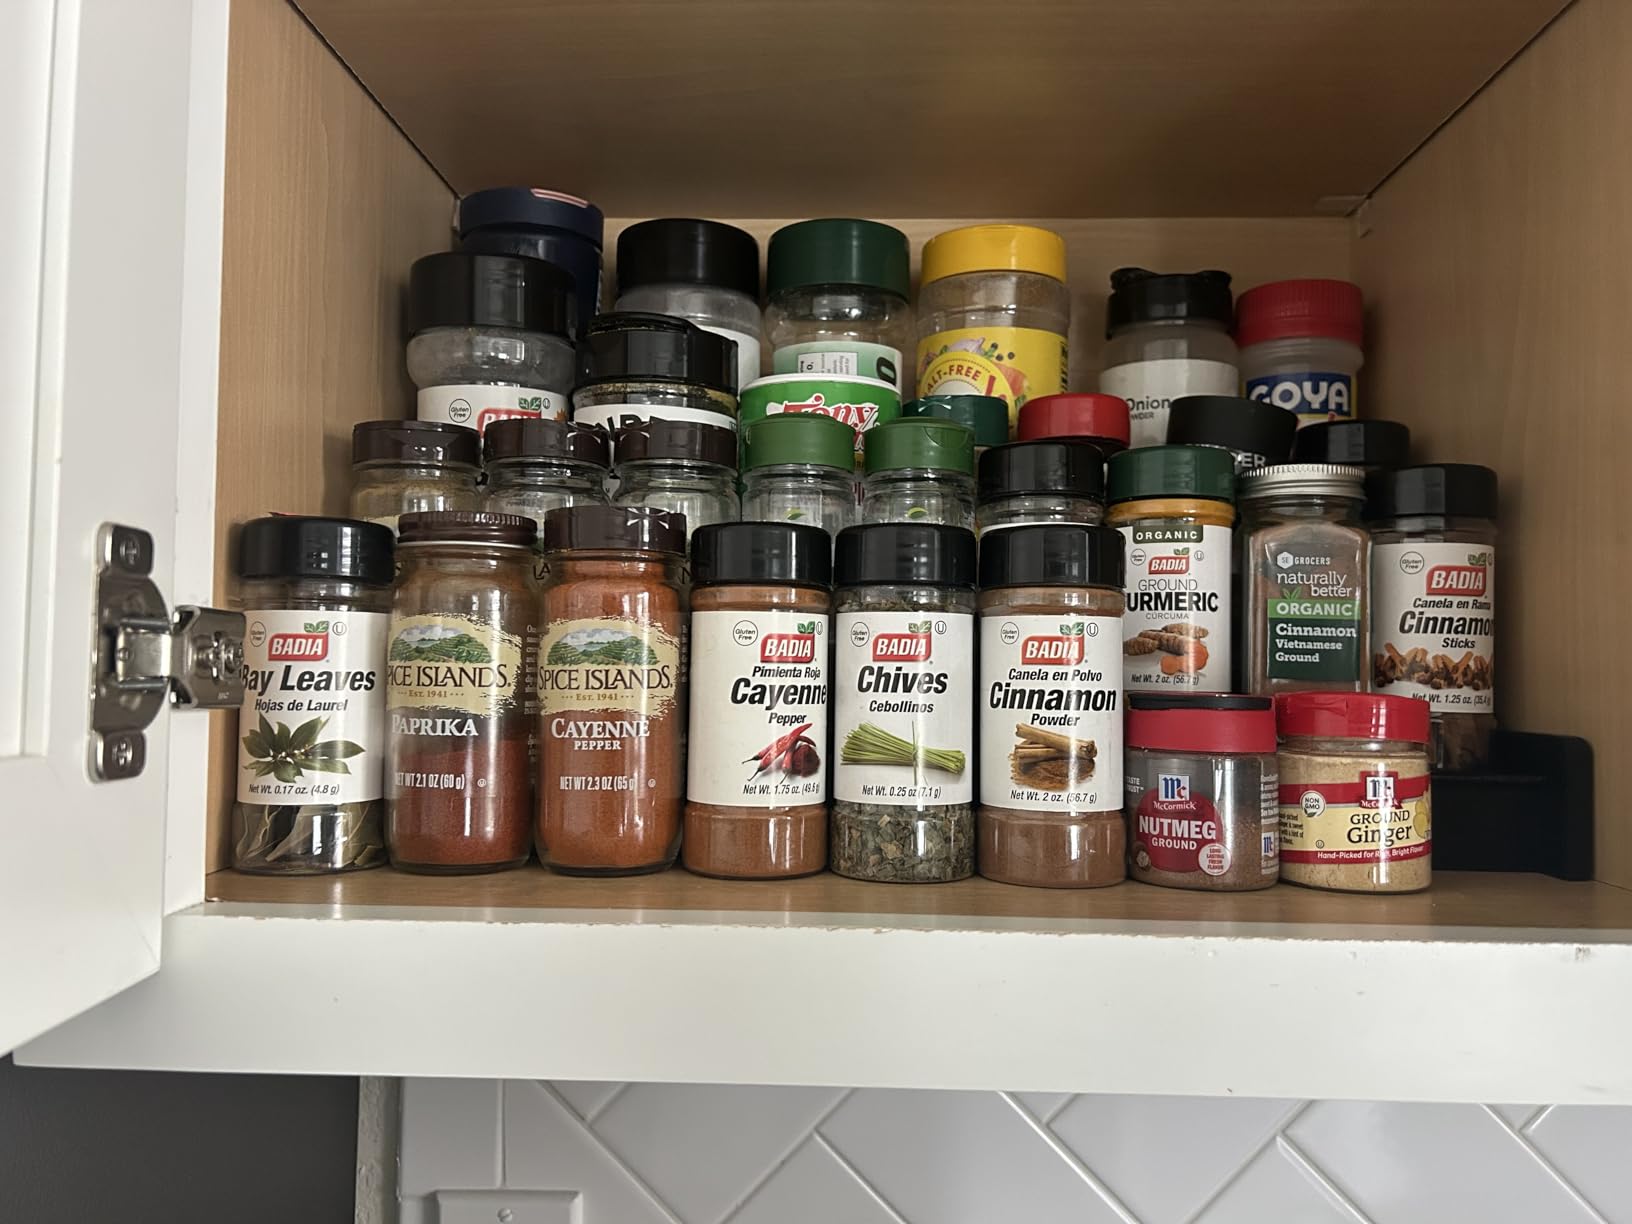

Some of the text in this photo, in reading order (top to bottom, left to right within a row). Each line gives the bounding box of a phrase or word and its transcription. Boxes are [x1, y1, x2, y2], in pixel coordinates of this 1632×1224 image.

[925, 364, 982, 392] ALT-FREE
[1250, 381, 1348, 411] GOYA
[1127, 396, 1170, 411] Onion
[1136, 531, 1198, 540] ORGANIC
[1151, 559, 1187, 570] BADIA
[1295, 557, 1331, 565] GROCERS
[1138, 579, 1198, 592] GROUND
[1277, 571, 1347, 587] naturally
[1431, 571, 1483, 590] BADIA
[1311, 584, 1352, 597] better
[1127, 592, 1218, 612] URMERIC
[1413, 598, 1452, 609] Canela
[1456, 601, 1469, 609] en
[1276, 603, 1352, 616] ORGANIC
[1276, 624, 1357, 638] Cinnamon
[272, 638, 323, 656] BADIA
[765, 639, 811, 657] BADIA
[876, 638, 927, 656] BADIA
[1026, 641, 1080, 659] BADIA
[1275, 639, 1343, 650] Vietnamese
[1442, 638, 1475, 649] Sticks
[1275, 652, 1320, 663] Ground
[417, 664, 507, 688] ISLANDS
[539, 665, 670, 690] SPICE ISLANDS
[752, 666, 821, 678] Pimienta Roja
[1009, 668, 1103, 682] Canela en Polvo
[1131, 674, 1142, 683] Net
[1143, 674, 1152, 683] Wt.
[1155, 675, 1160, 683] 2
[242, 664, 377, 697] Bay Leaves
[857, 666, 948, 694] Chives
[427, 690, 448, 698] 1941
[597, 693, 618, 701] 1941
[731, 678, 827, 711] Cayenne
[989, 682, 1117, 711] Cinnamon
[1429, 694, 1441, 704] Wt.
[1445, 695, 1461, 704] 1.25
[255, 699, 348, 713] Hojas de Laurel
[869, 700, 934, 713] Cebollinos
[391, 714, 479, 737] PAPRIKA
[768, 712, 807, 727] Pepper
[1031, 714, 1080, 726] Powder
[551, 718, 650, 739] CAYENNE
[574, 740, 622, 750] PEPPER
[404, 773, 415, 787] WT
[416, 774, 426, 788] 2.1
[428, 775, 439, 788] OZ
[440, 774, 454, 789] (60
[456, 774, 465, 789] g)
[560, 776, 573, 790] NET
[574, 776, 586, 790] WT
[587, 776, 600, 790] 2.3
[602, 776, 613, 790] OZ
[614, 776, 627, 792] (65
[249, 784, 260, 793] Net
[274, 785, 294, 795] 0.17
[295, 786, 308, 794] oz.
[311, 785, 329, 796] (4.8
[330, 784, 340, 796] g)
[743, 784, 757, 794] Net
[758, 784, 771, 795] Wt.
[774, 784, 790, 794] 1.75
[792, 785, 801, 794] oz.
[862, 785, 874, 795] Net
[875, 785, 887, 796] Wt.
[889, 786, 906, 797] 0.25
[918, 786, 933, 798] (7.1
[934, 787, 942, 799] g)
[1010, 790, 1097, 804] Net Wt. 2 oz. (56.7 g)
[1153, 801, 1196, 811] McCormick
[1139, 815, 1216, 840] NUTMEG
[1347, 825, 1412, 847] Ginger
[1151, 837, 1197, 850] GROUND
[1317, 852, 1362, 860] Hand-Picked
[1363, 850, 1374, 858] for
[1392, 848, 1409, 857] Bright
